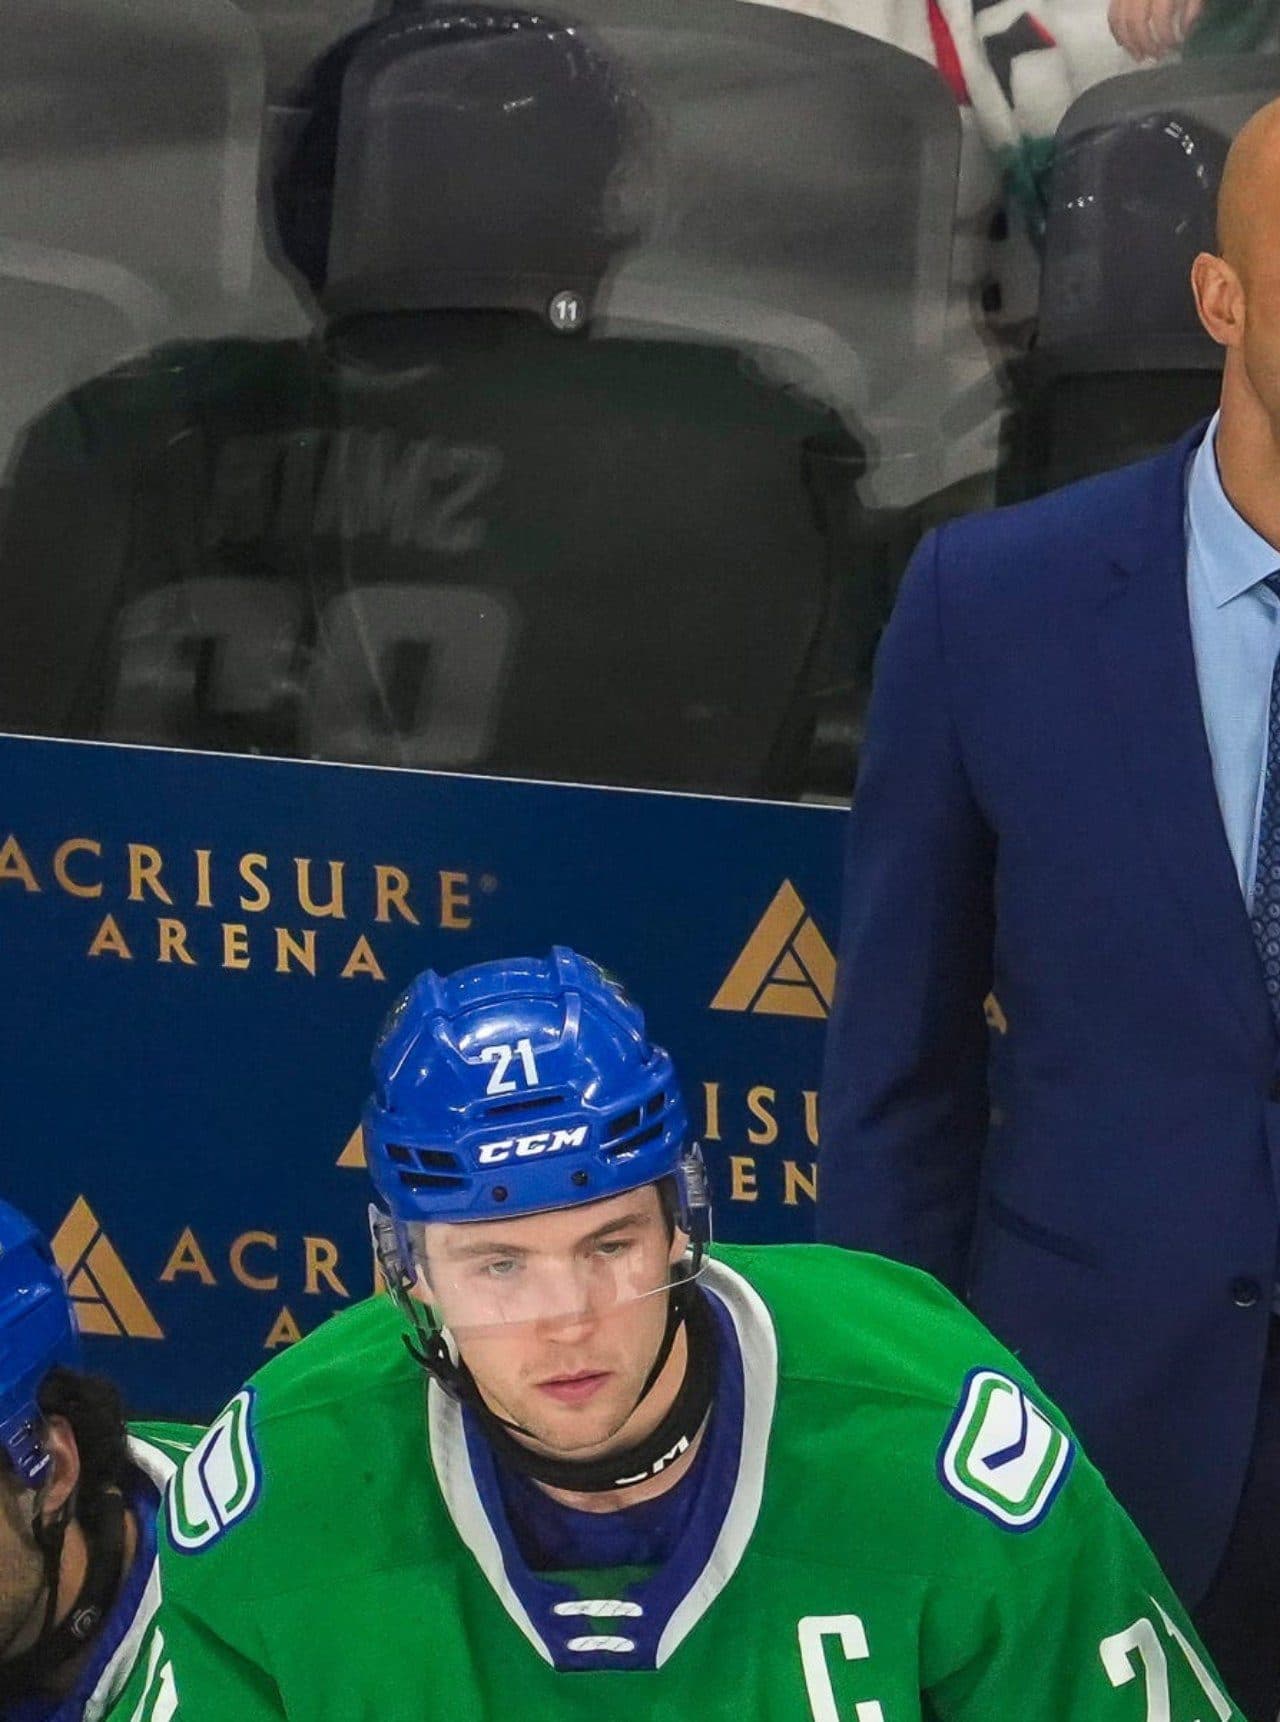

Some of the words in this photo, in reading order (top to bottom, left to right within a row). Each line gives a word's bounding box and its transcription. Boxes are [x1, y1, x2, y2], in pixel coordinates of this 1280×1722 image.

[556, 300, 577, 321] 11
[88, 913, 386, 981] ARENA
[480, 1038, 539, 1095] 21
[478, 1126, 588, 1164] CCM
[159, 1227, 390, 1298] ACR
[798, 1614, 886, 1722] C
